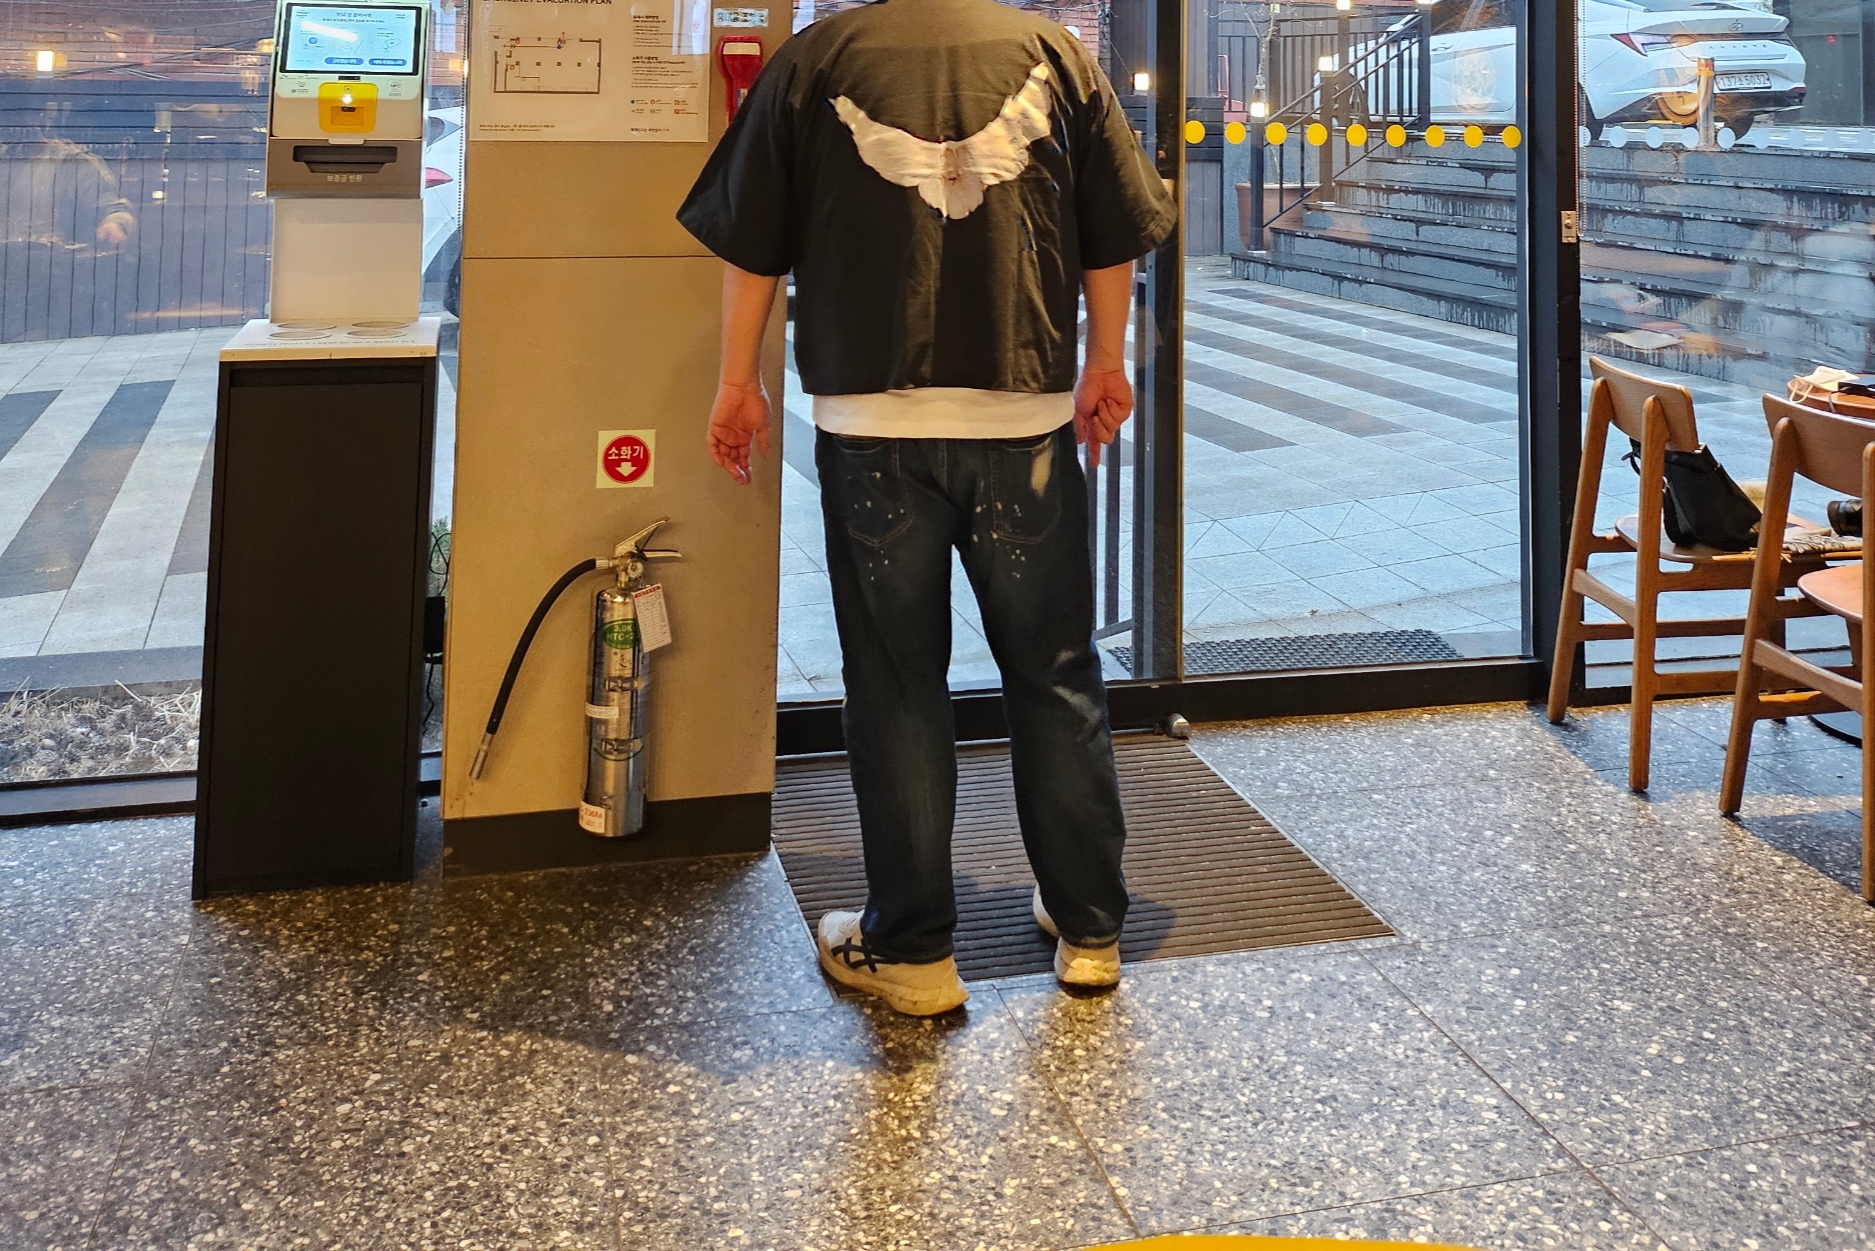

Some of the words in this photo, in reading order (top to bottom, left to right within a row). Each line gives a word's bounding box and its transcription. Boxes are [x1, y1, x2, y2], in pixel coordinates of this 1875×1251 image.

[326, 174, 348, 183] 보증금
[348, 174, 363, 183] 반환
[607, 445, 644, 460] 소화기
